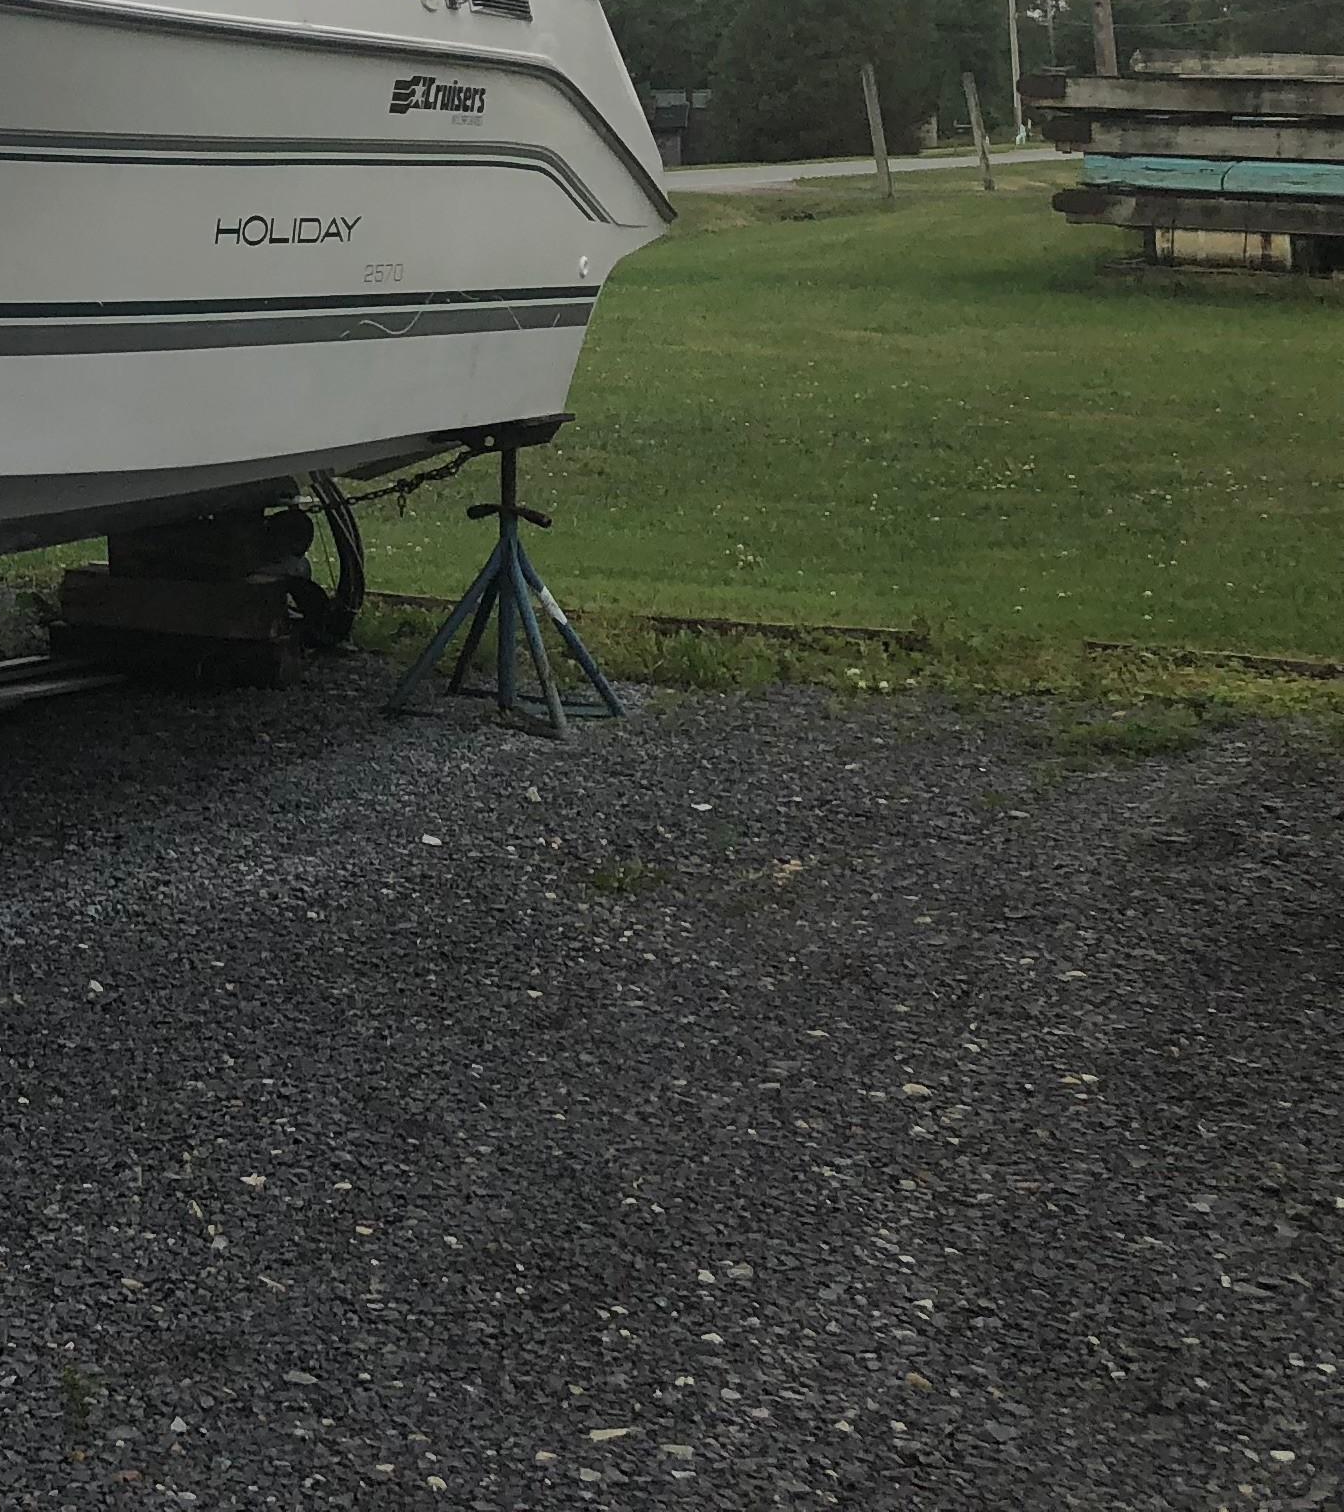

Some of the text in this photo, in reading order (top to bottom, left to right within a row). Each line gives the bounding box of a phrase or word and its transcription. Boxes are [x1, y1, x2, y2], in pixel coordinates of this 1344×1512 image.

[423, 76, 486, 114] Cruisers
[215, 215, 362, 246] HOLIDAY
[363, 263, 404, 283] 2570
